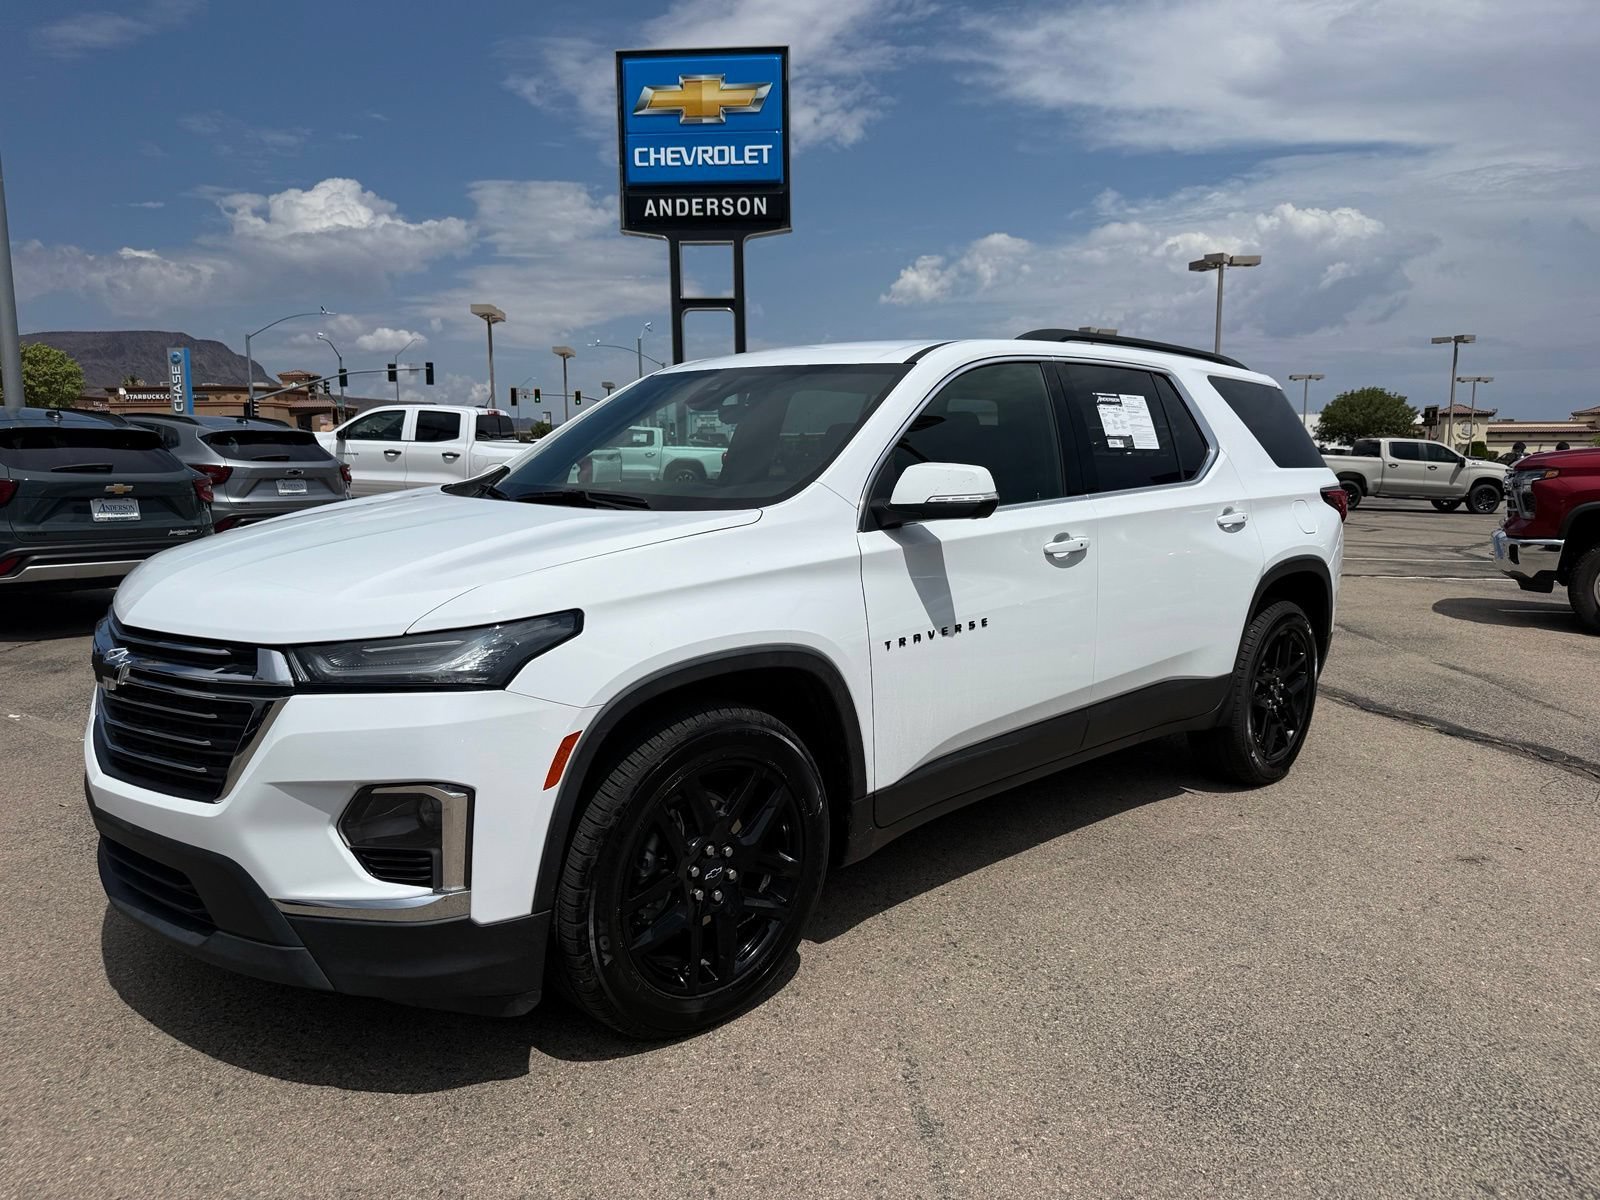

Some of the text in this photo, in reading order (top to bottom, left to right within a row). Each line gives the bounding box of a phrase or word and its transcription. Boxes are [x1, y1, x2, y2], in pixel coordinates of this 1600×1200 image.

[634, 145, 773, 166] CHEVROLET
[644, 197, 767, 217] ANDERSON
[172, 365, 184, 412] CHASE
[98, 503, 135, 513] ANDERSON
[884, 617, 988, 652] TRAVERSE
